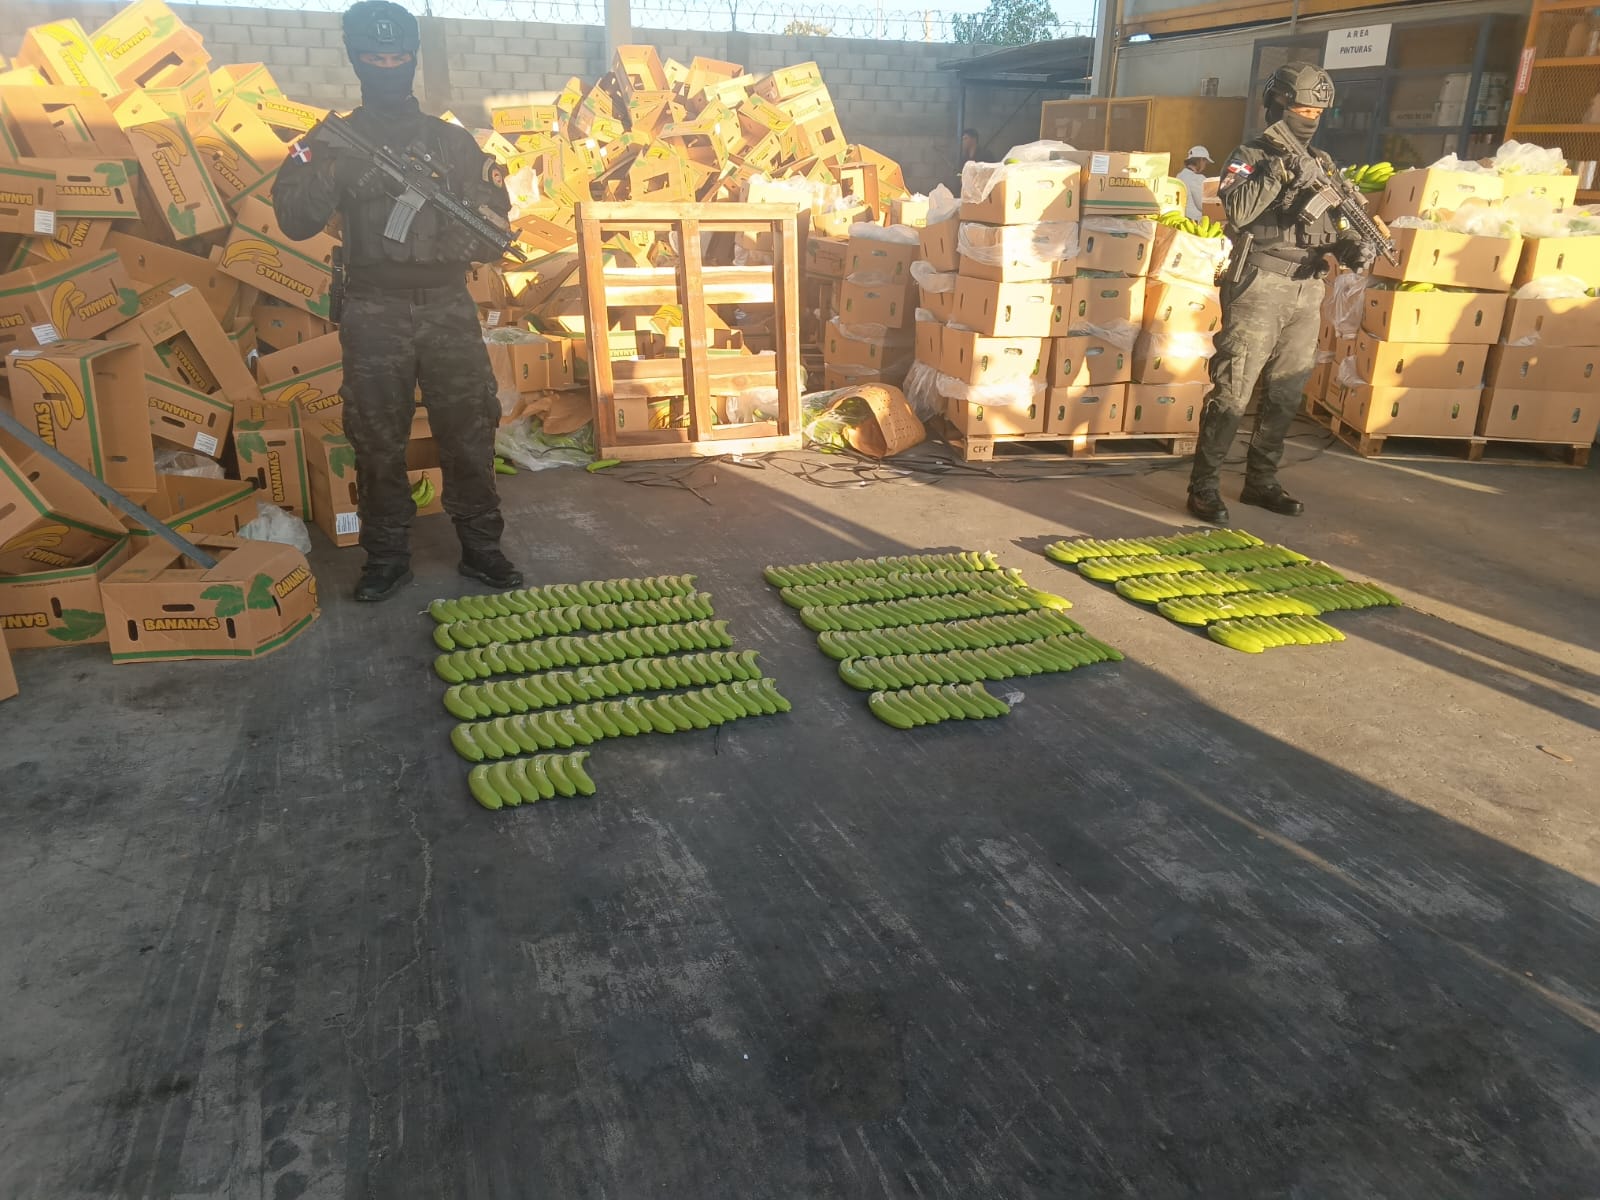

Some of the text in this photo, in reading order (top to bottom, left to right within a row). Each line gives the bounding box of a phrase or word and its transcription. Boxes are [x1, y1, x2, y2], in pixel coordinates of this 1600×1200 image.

[1340, 45, 1373, 55] PINTURAS
[152, 150, 187, 205] BANANAS
[256, 263, 314, 298] BANANAS
[78, 292, 118, 321] BANANAS
[33, 401, 57, 451] ANAS
[148, 397, 205, 425] BANANAS
[266, 450, 286, 503] BANANAS
[275, 564, 313, 599] BANANAS
[143, 616, 221, 632] BANANAS
